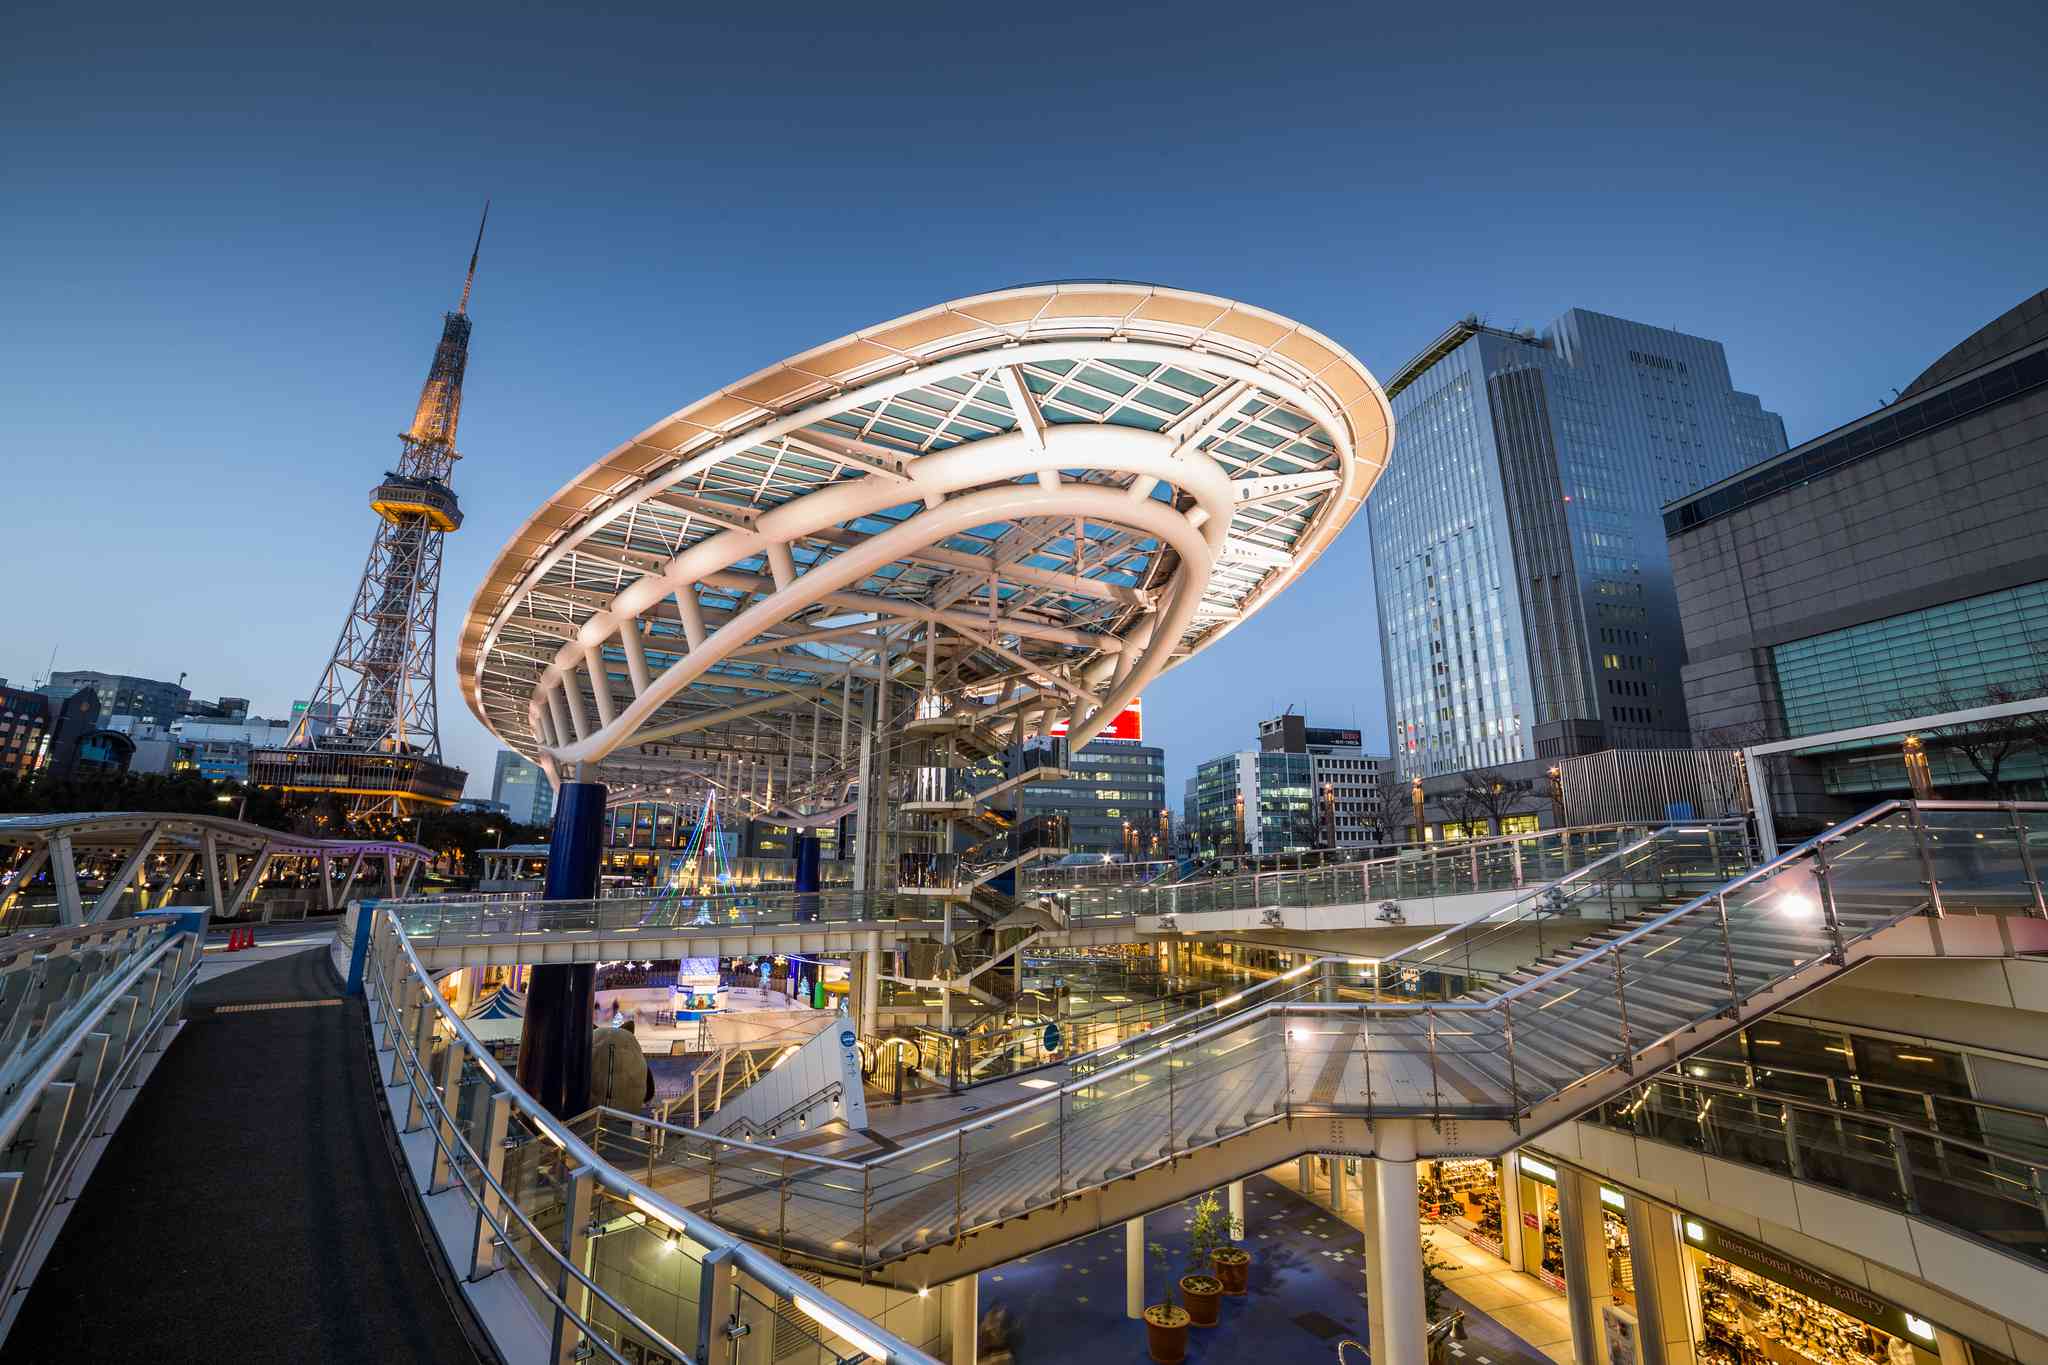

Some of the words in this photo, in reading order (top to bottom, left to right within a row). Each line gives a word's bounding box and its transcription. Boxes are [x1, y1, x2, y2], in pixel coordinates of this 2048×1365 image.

[1717, 1235, 1792, 1274] International
[1793, 1267, 1832, 1291] shoes
[1835, 1286, 1886, 1316] gallery
